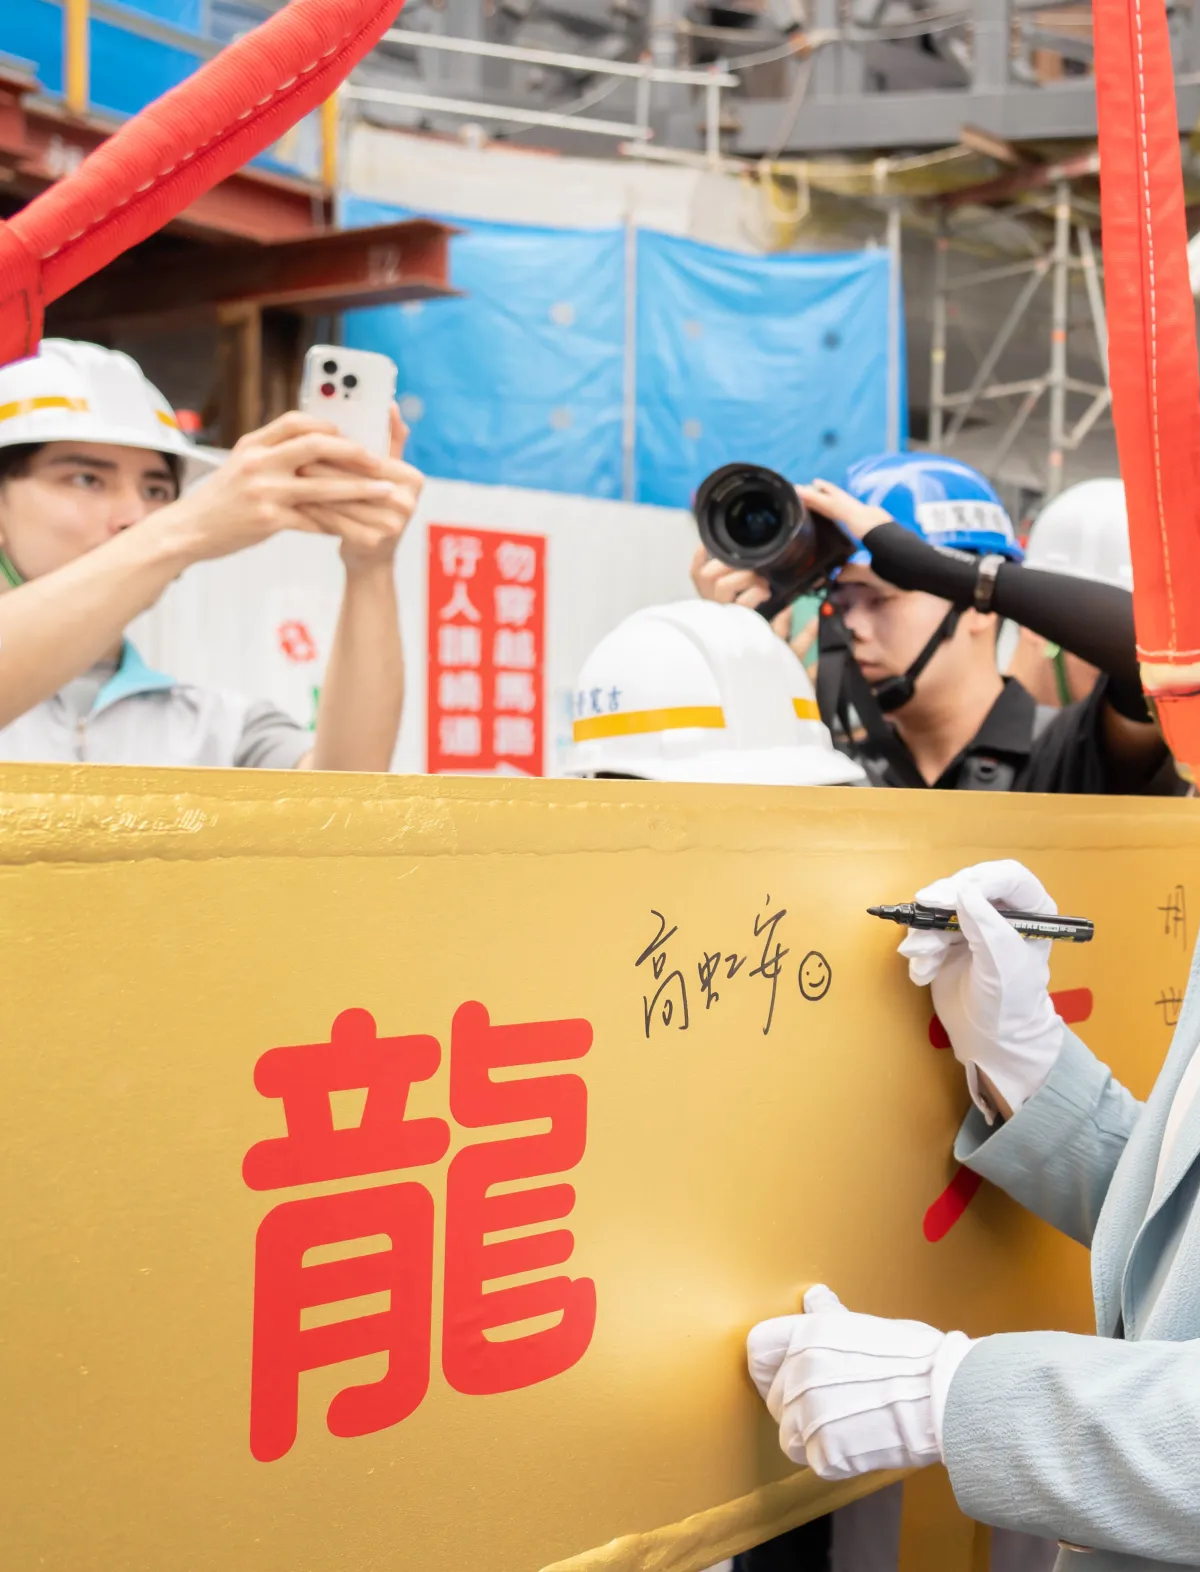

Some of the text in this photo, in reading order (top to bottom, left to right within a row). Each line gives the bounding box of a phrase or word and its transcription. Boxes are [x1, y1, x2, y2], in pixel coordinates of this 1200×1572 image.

[438, 533, 483, 757] 行人請繞道
[494, 541, 537, 757] 勿穿越馬路
[634, 893, 790, 1039] 高虹安
[241, 999, 597, 1463] 龍
